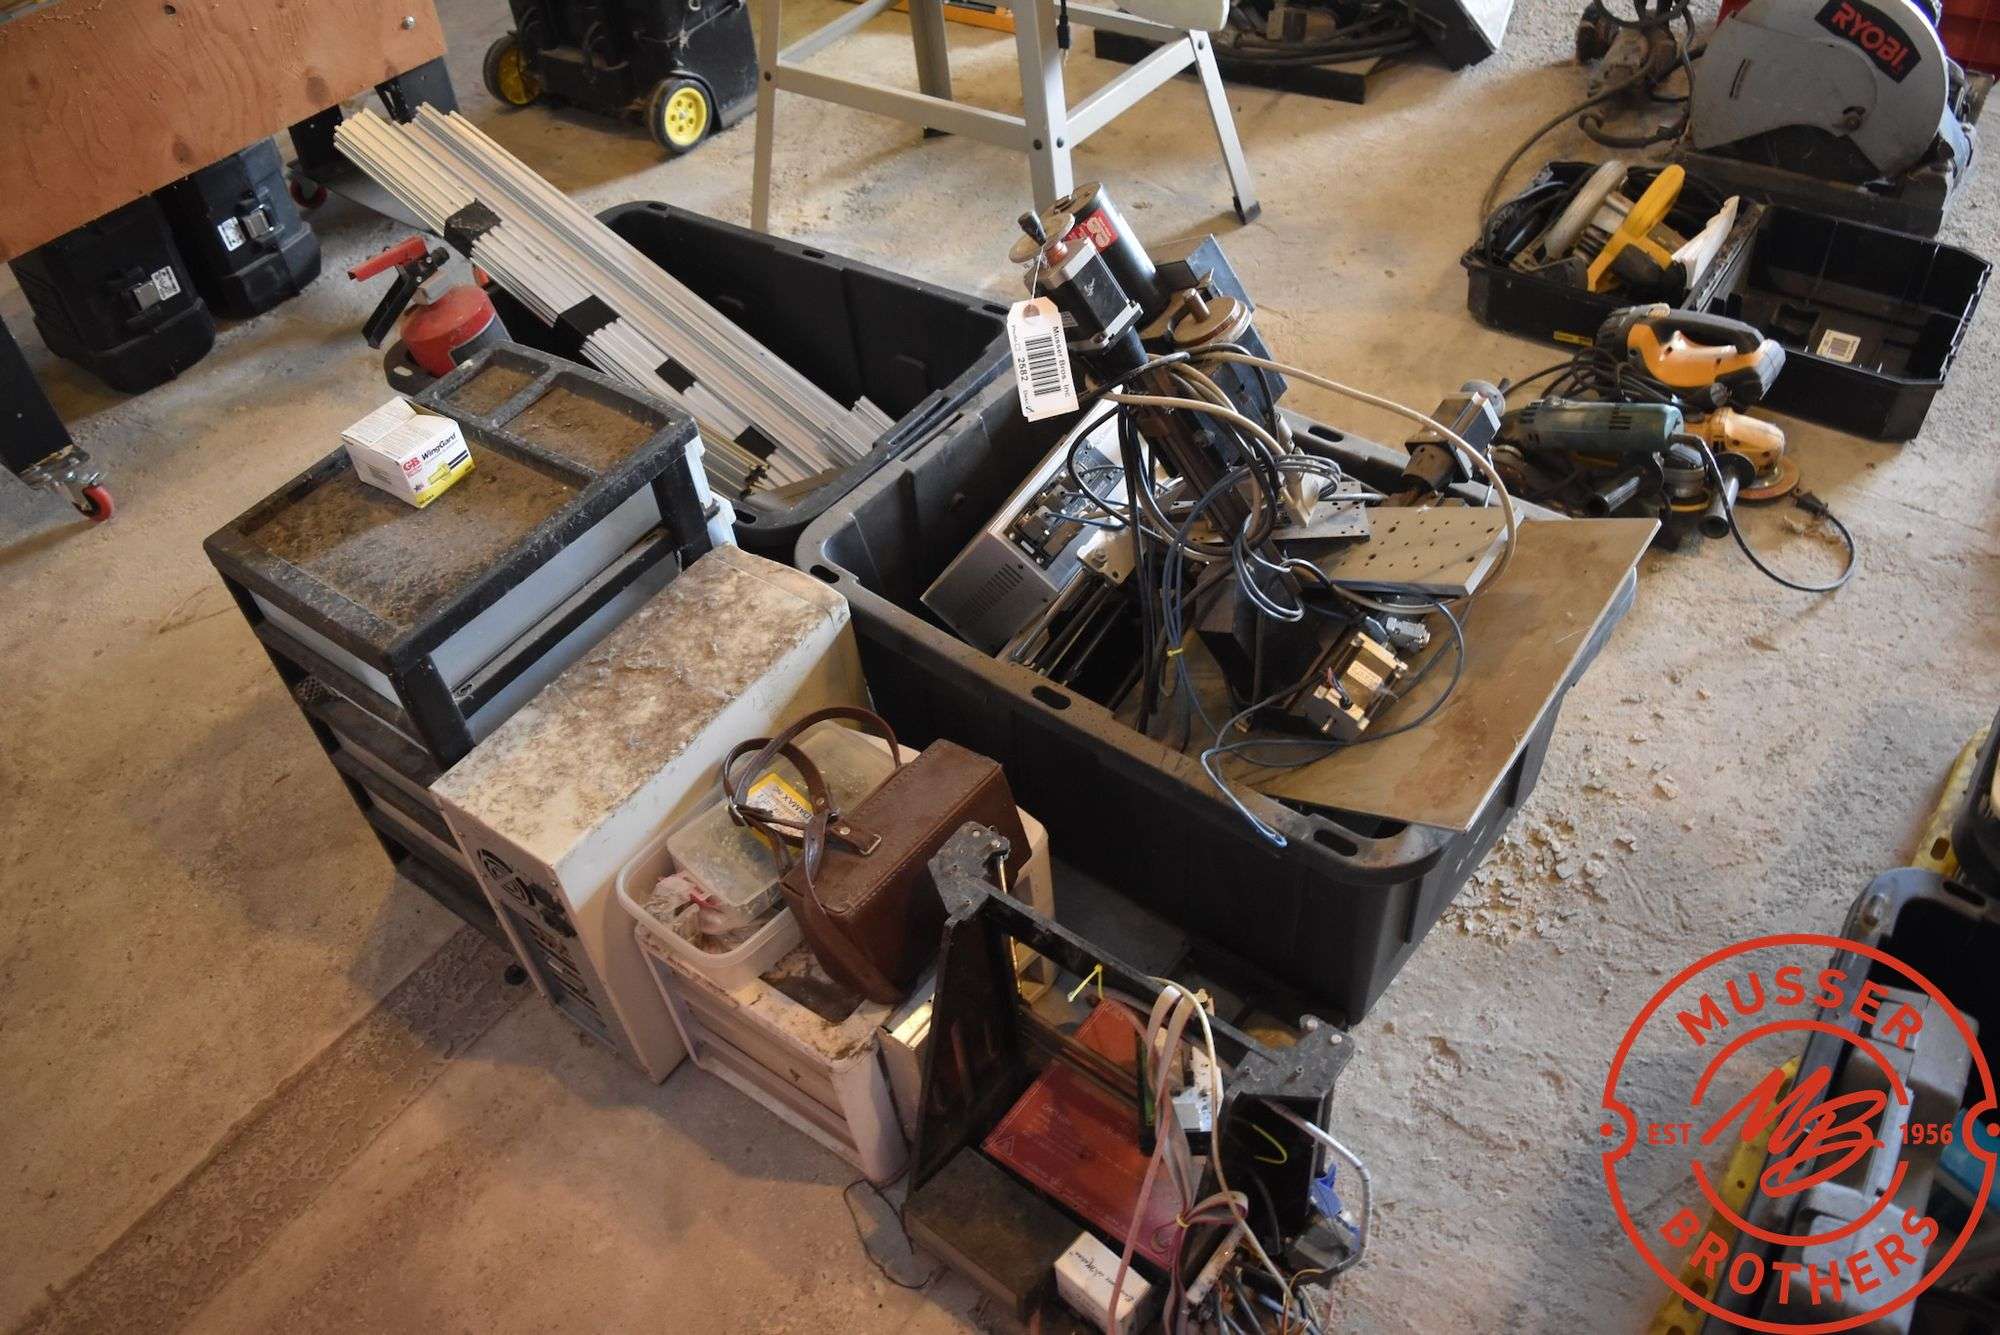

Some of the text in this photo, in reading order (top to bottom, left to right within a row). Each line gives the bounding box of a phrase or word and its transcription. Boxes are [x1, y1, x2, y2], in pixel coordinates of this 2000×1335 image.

[1832, 2, 1909, 66] RYOBI
[1052, 326, 1063, 357] Musser
[1017, 358, 1029, 382] 2582
[421, 432, 456, 461] WingGard
